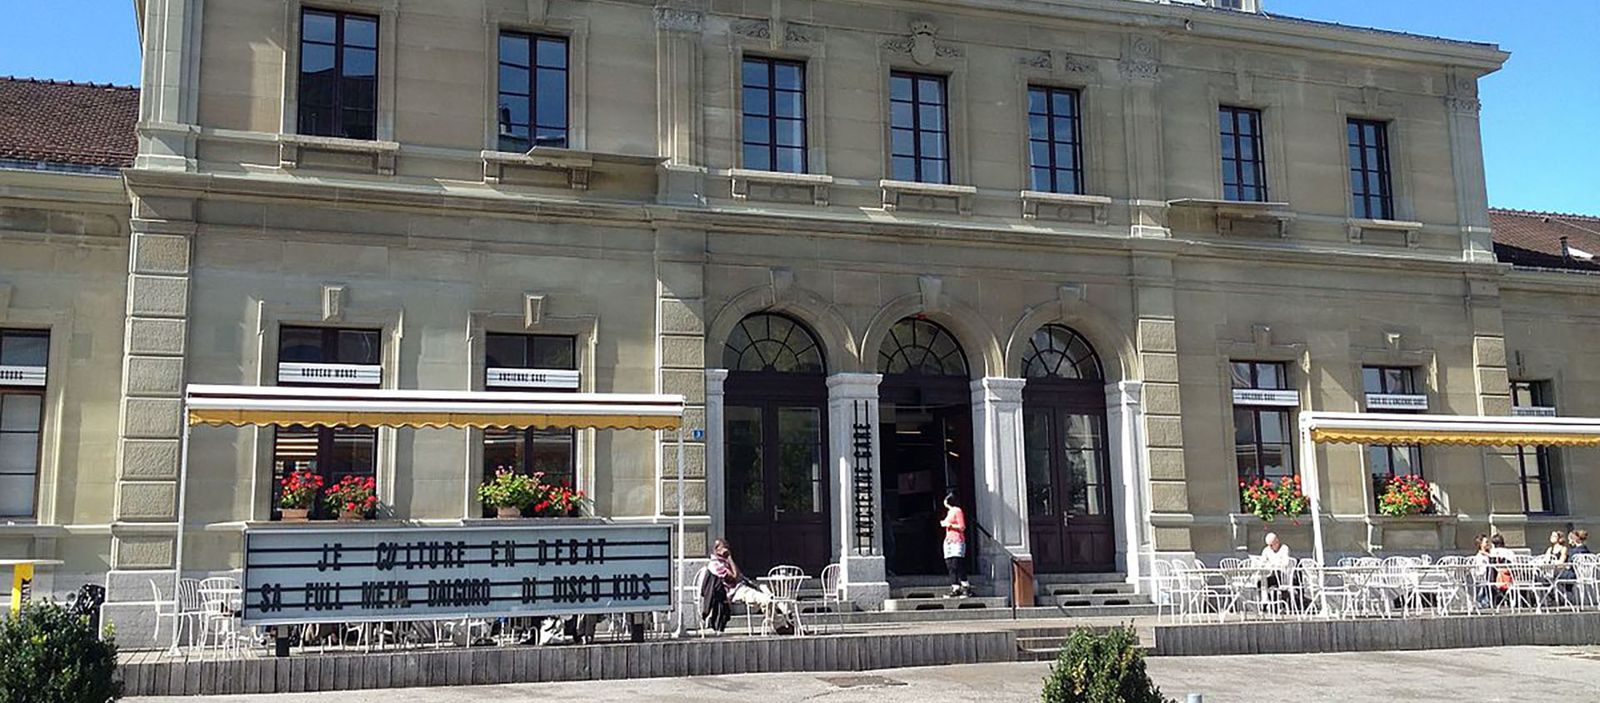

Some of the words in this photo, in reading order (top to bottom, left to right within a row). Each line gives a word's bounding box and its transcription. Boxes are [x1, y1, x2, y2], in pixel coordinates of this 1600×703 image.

[853, 424, 872, 458] GARE
[854, 466, 873, 537] ANCIENNE
[318, 543, 342, 572] JE
[377, 541, 465, 571] CULTURE
[491, 540, 515, 567] EN
[538, 538, 606, 565] DEBAT
[260, 583, 282, 613] SA
[305, 582, 343, 611] FULL
[361, 581, 412, 609] METAL
[522, 576, 536, 603] DI
[553, 574, 601, 602] DISCO
[613, 573, 650, 600] KIDS
